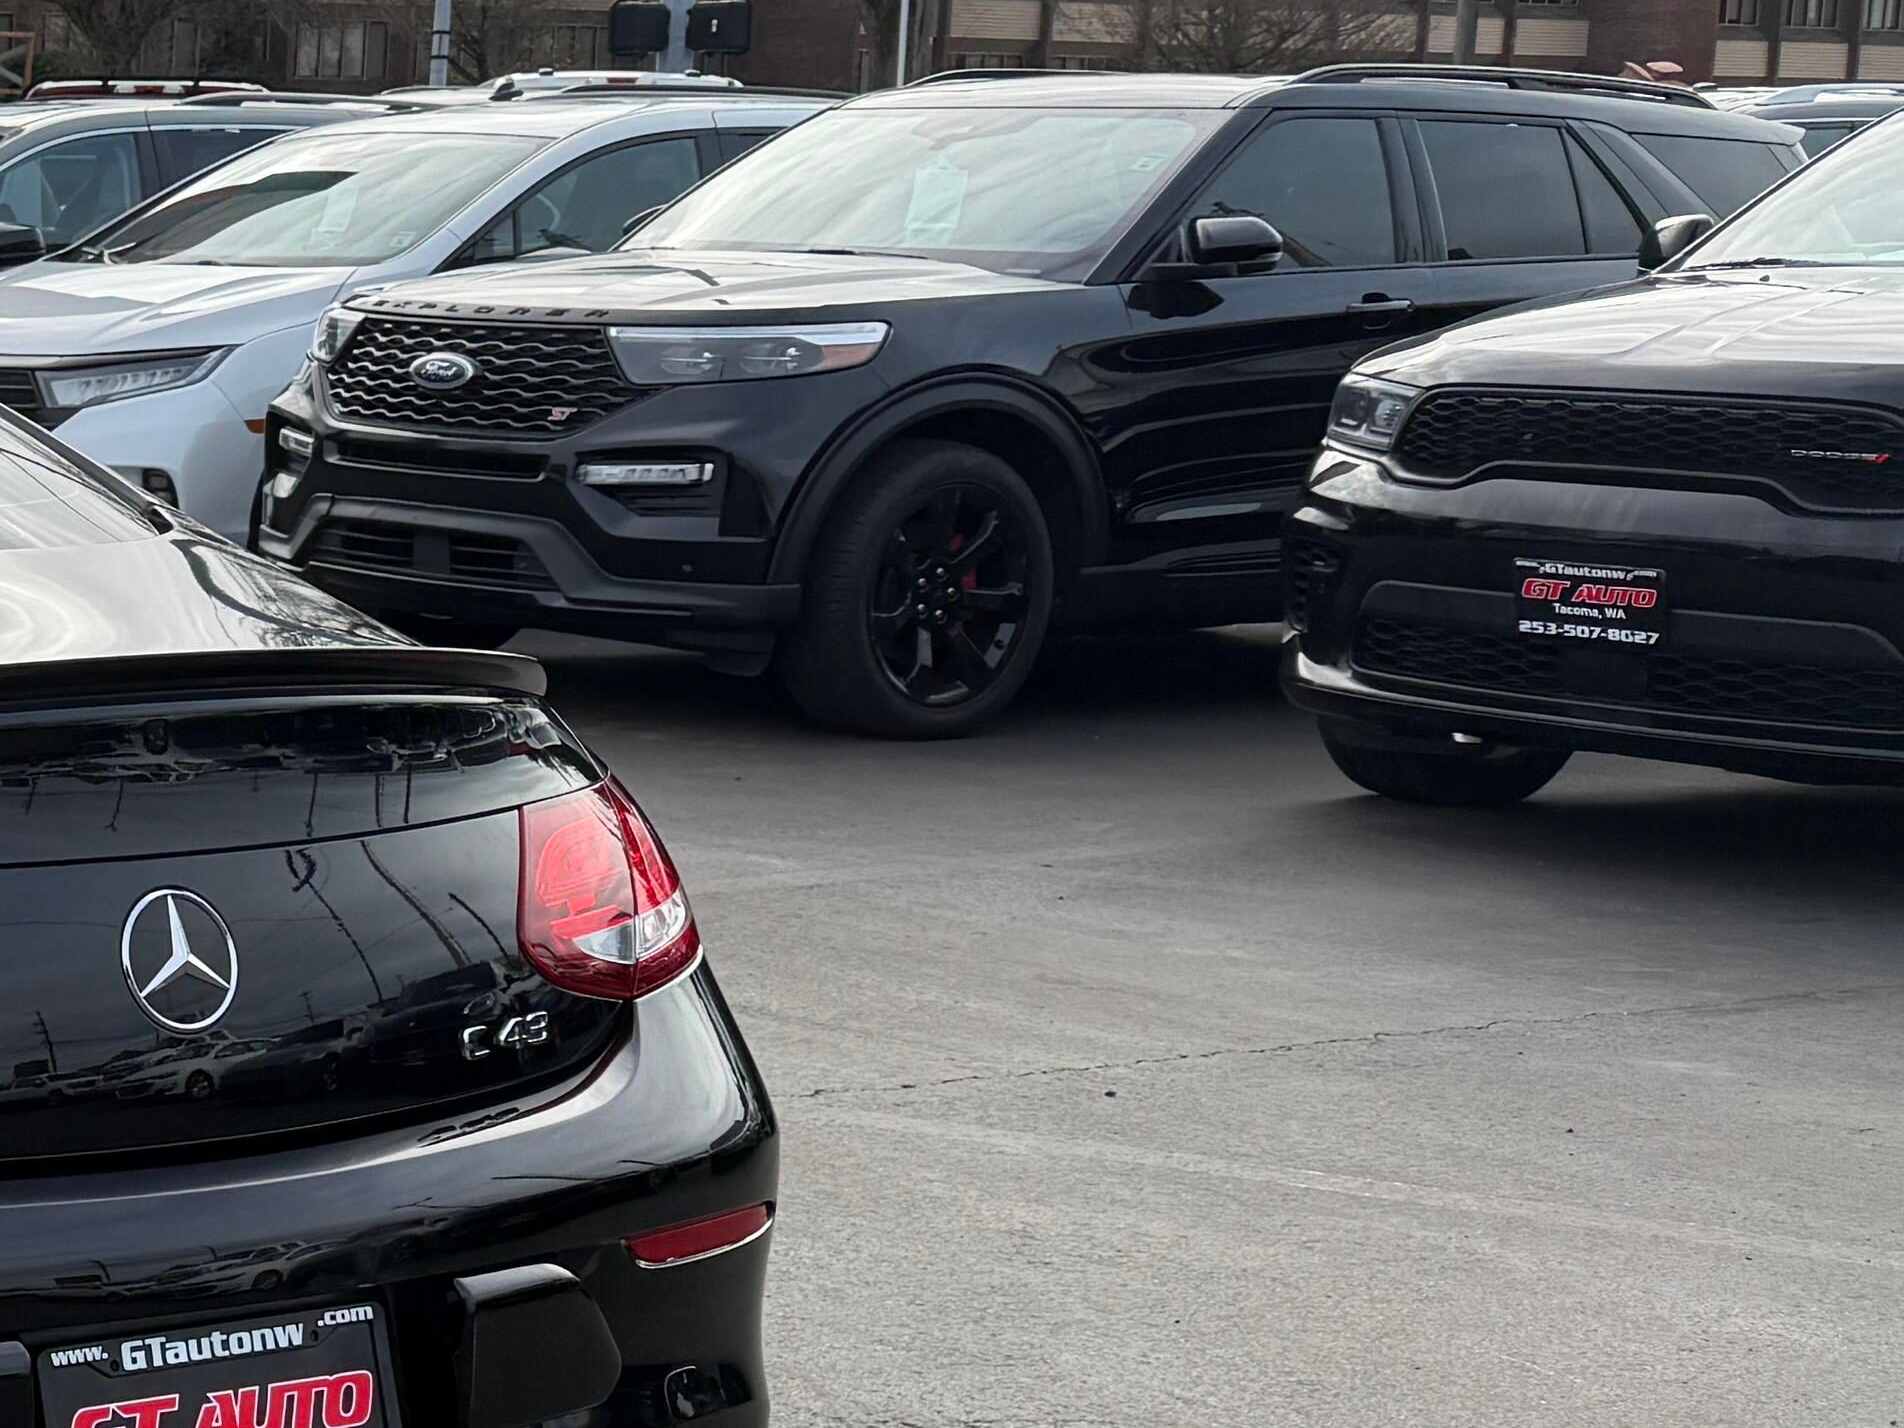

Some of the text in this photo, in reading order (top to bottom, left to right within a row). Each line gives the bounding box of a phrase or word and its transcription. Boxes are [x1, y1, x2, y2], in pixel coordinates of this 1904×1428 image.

[373, 299, 610, 318] EXPLORER
[421, 360, 459, 380] Ford
[547, 408, 578, 421] ST
[1791, 449, 1877, 460] DODGE
[1544, 562, 1627, 579] GTautonw
[1521, 577, 1657, 608] GT AUTO
[1552, 603, 1626, 620] Tacoma, WA
[1518, 620, 1660, 644] 253-507-8027
[50, 1306, 374, 1372] www. GTautonw .com
